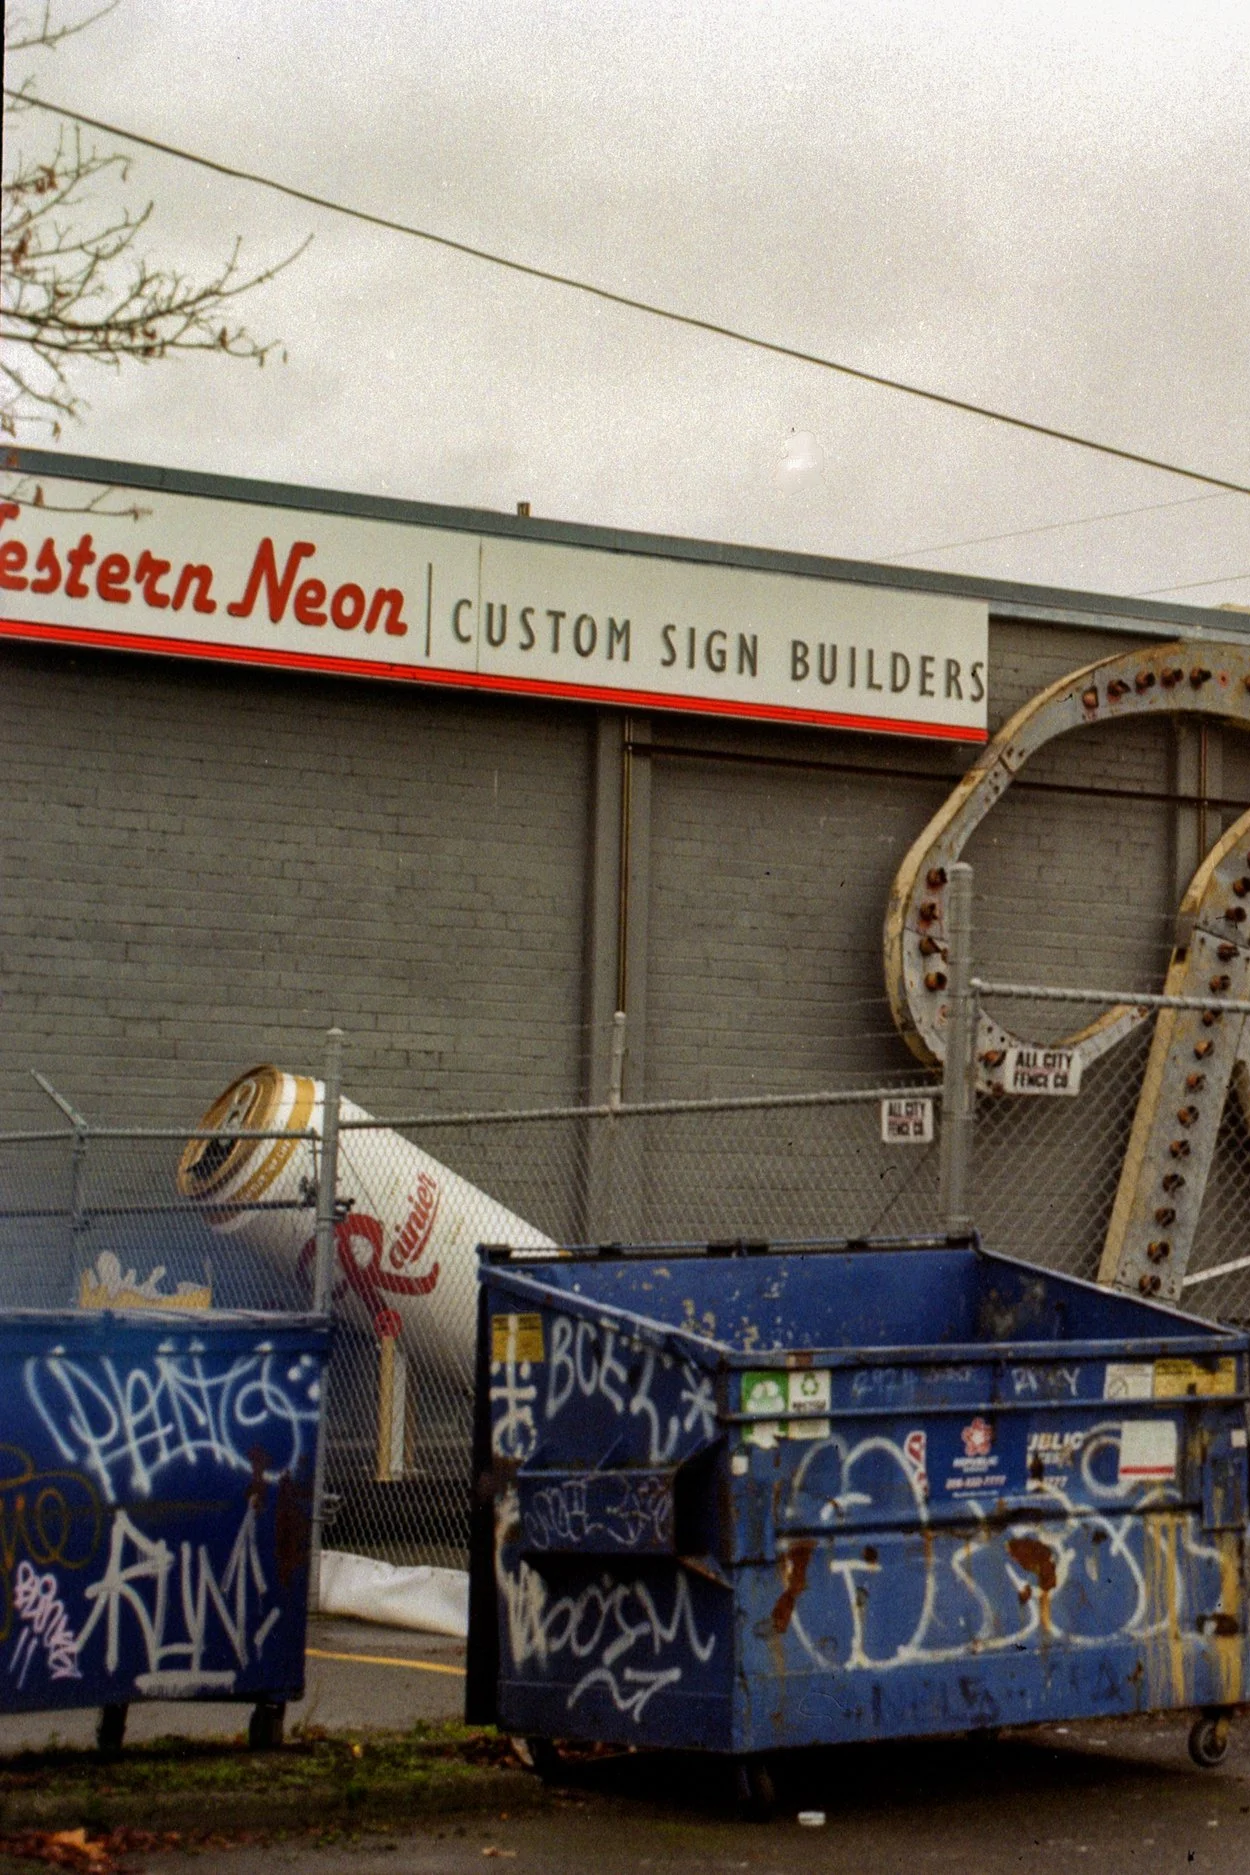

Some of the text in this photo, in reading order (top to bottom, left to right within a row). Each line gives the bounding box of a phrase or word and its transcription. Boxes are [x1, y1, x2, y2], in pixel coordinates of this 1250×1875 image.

[0, 503, 409, 637] estern Neon
[452, 598, 987, 704] CUSTOM SIGN BUILDERS
[1043, 1052, 1074, 1069] CITY
